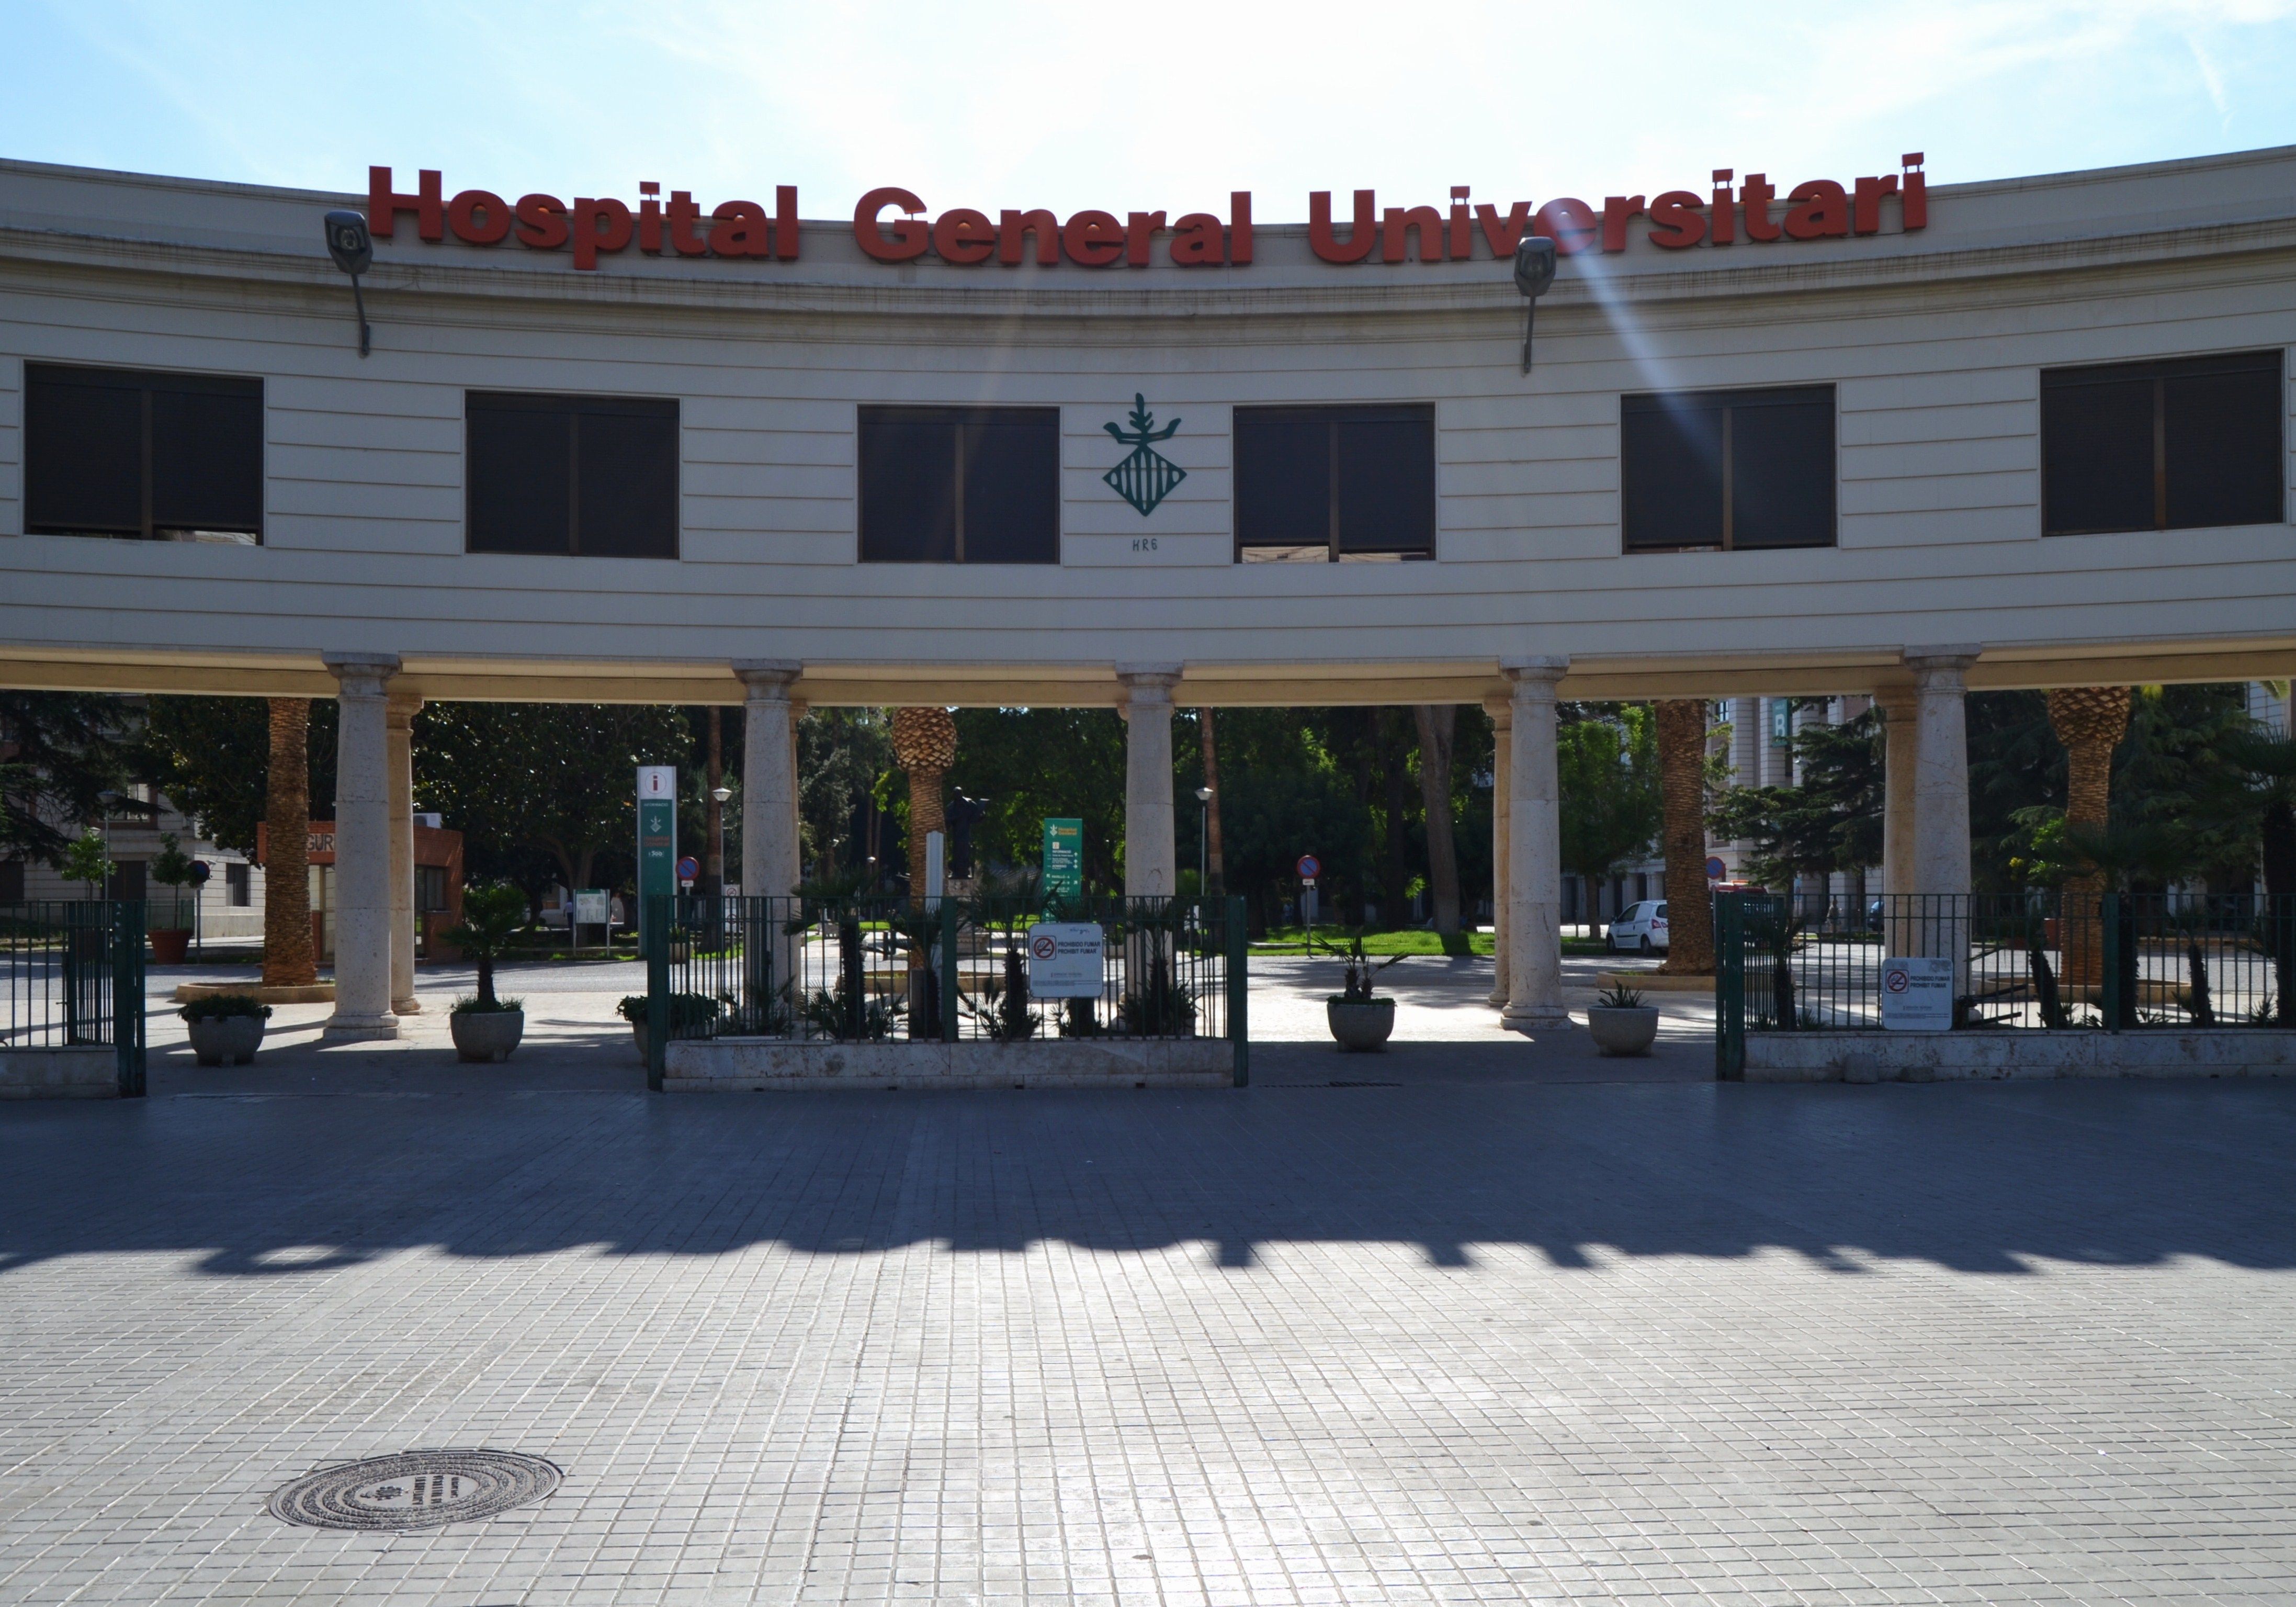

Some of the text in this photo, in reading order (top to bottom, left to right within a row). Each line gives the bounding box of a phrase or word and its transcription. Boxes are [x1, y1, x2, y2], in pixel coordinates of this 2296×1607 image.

[369, 152, 1927, 270] Hospital General Universitari
